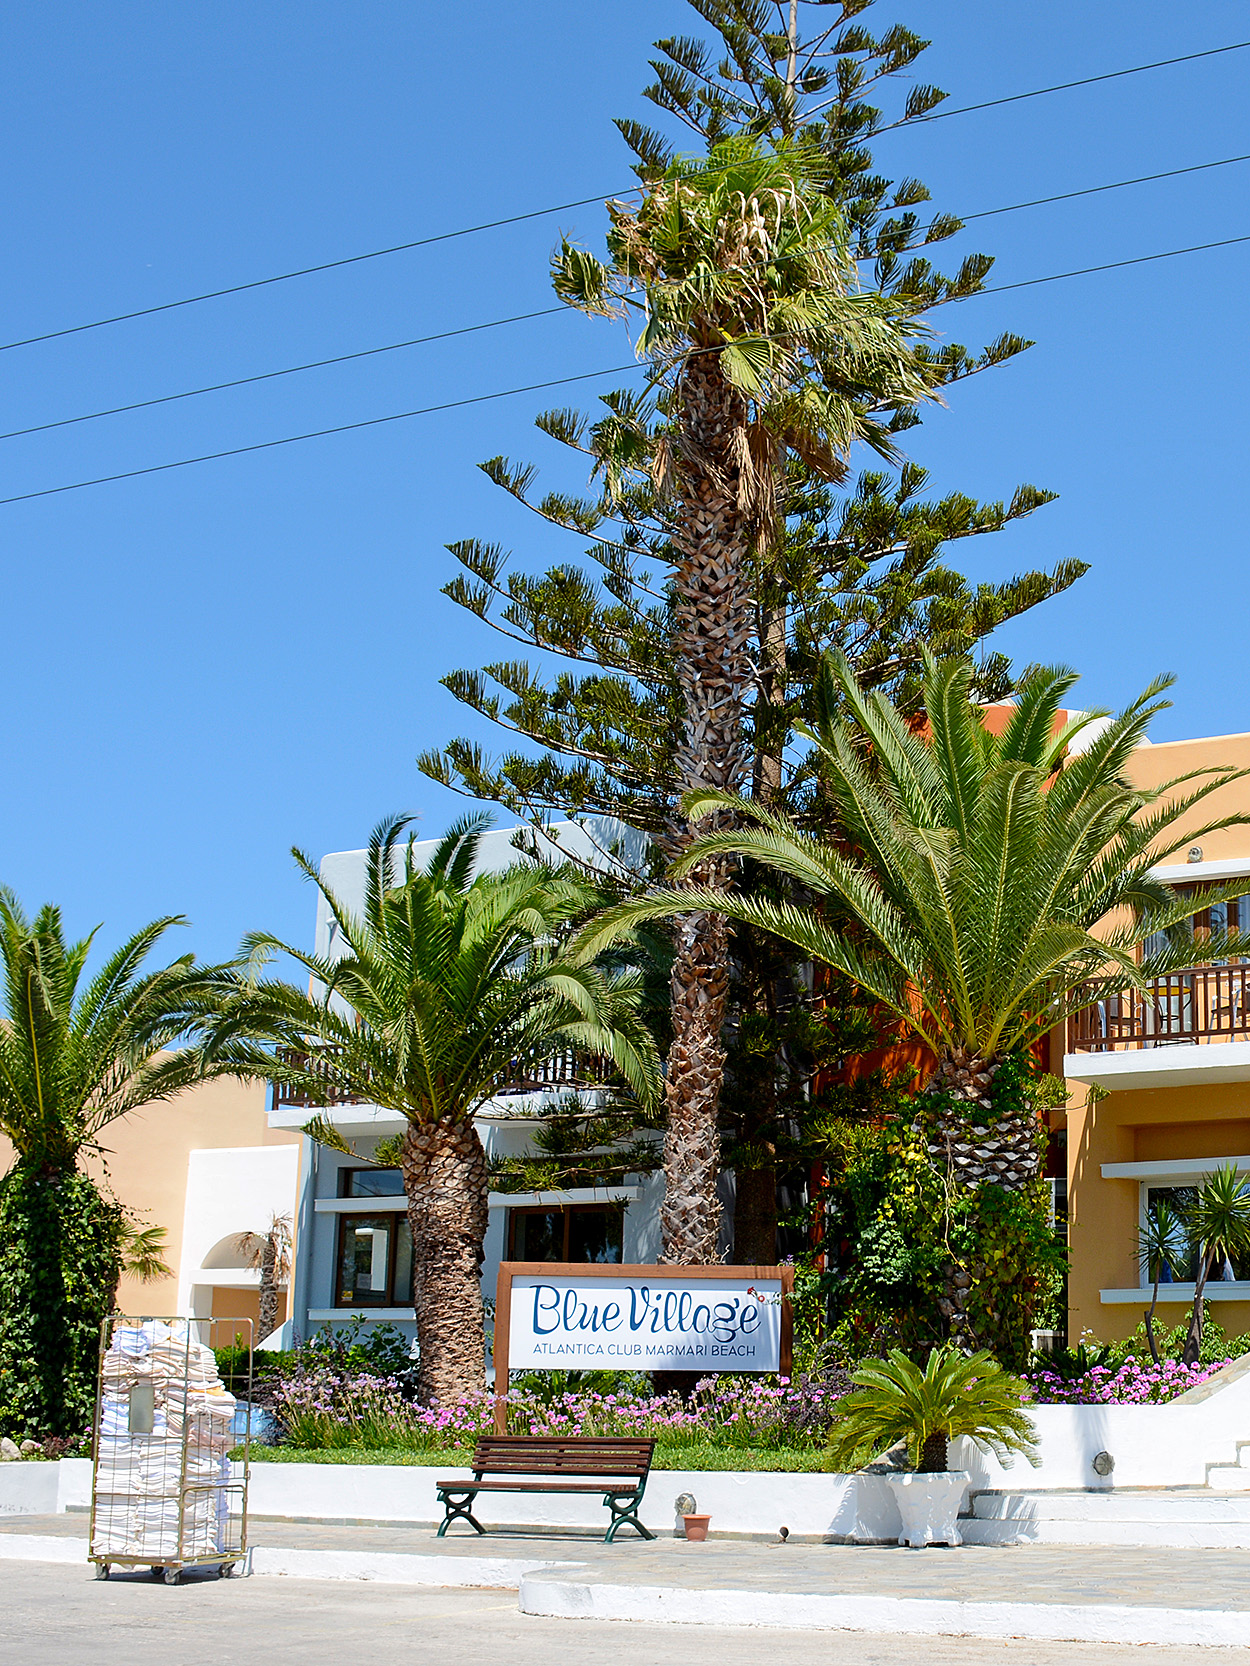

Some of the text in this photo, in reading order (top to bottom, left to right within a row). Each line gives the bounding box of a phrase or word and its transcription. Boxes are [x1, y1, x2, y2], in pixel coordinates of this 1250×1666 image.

[530, 1285, 762, 1343] Blue Village
[533, 1343, 756, 1357] ATLANTICA CLUB MARMARI BEACH
